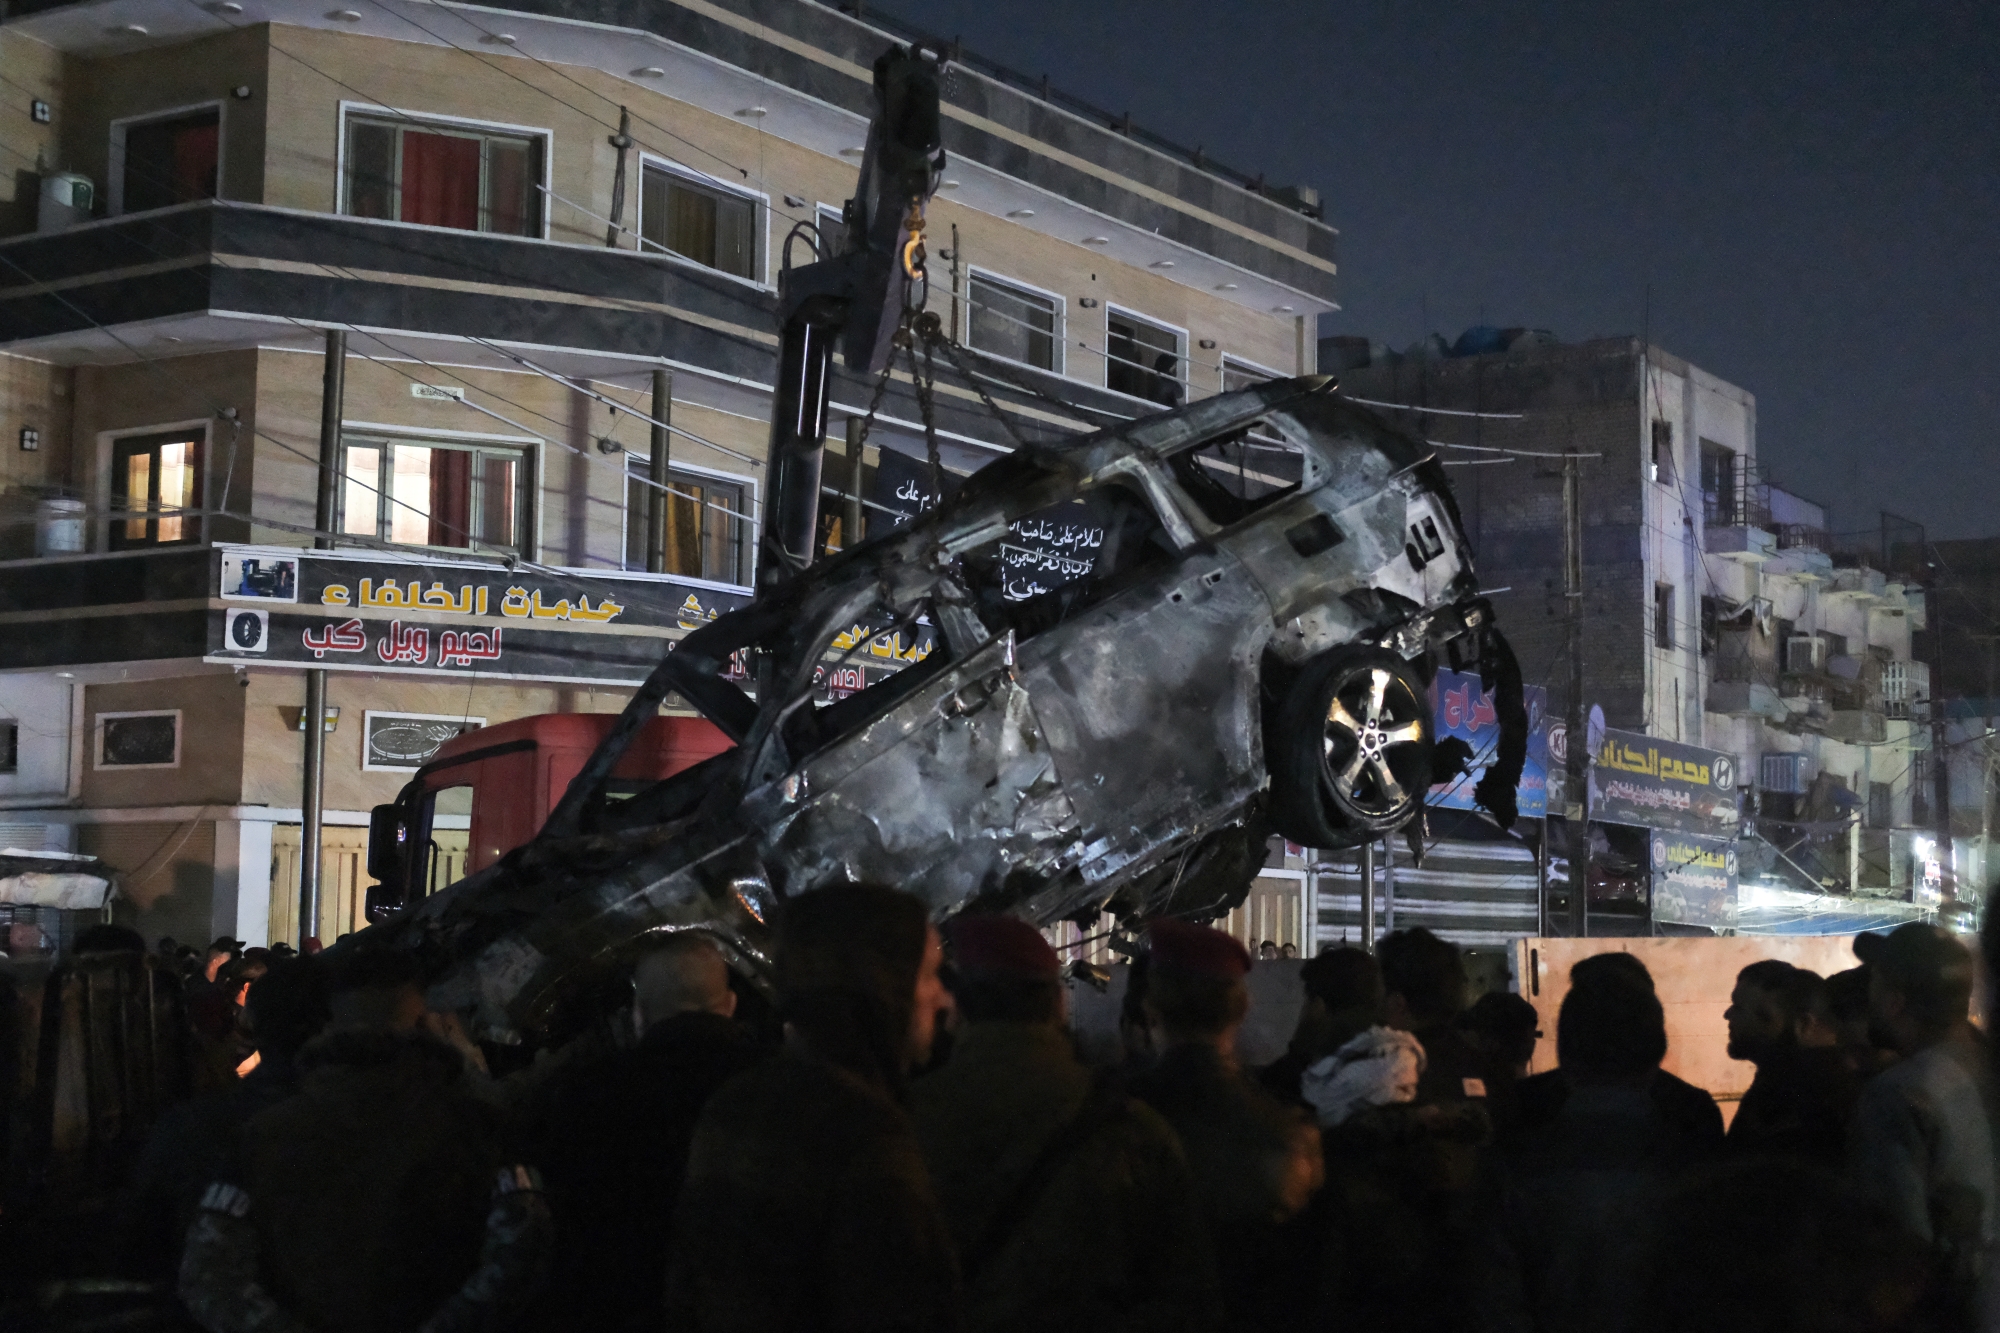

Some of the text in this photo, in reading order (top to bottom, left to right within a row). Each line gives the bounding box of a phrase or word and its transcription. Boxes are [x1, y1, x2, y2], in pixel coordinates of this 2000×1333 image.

[1074, 528, 1104, 552] لسلام
[321, 578, 626, 623] خدمات الخلفاء
[303, 618, 502, 667] لحيم ويل كب
[1659, 756, 1710, 790] مجمع
